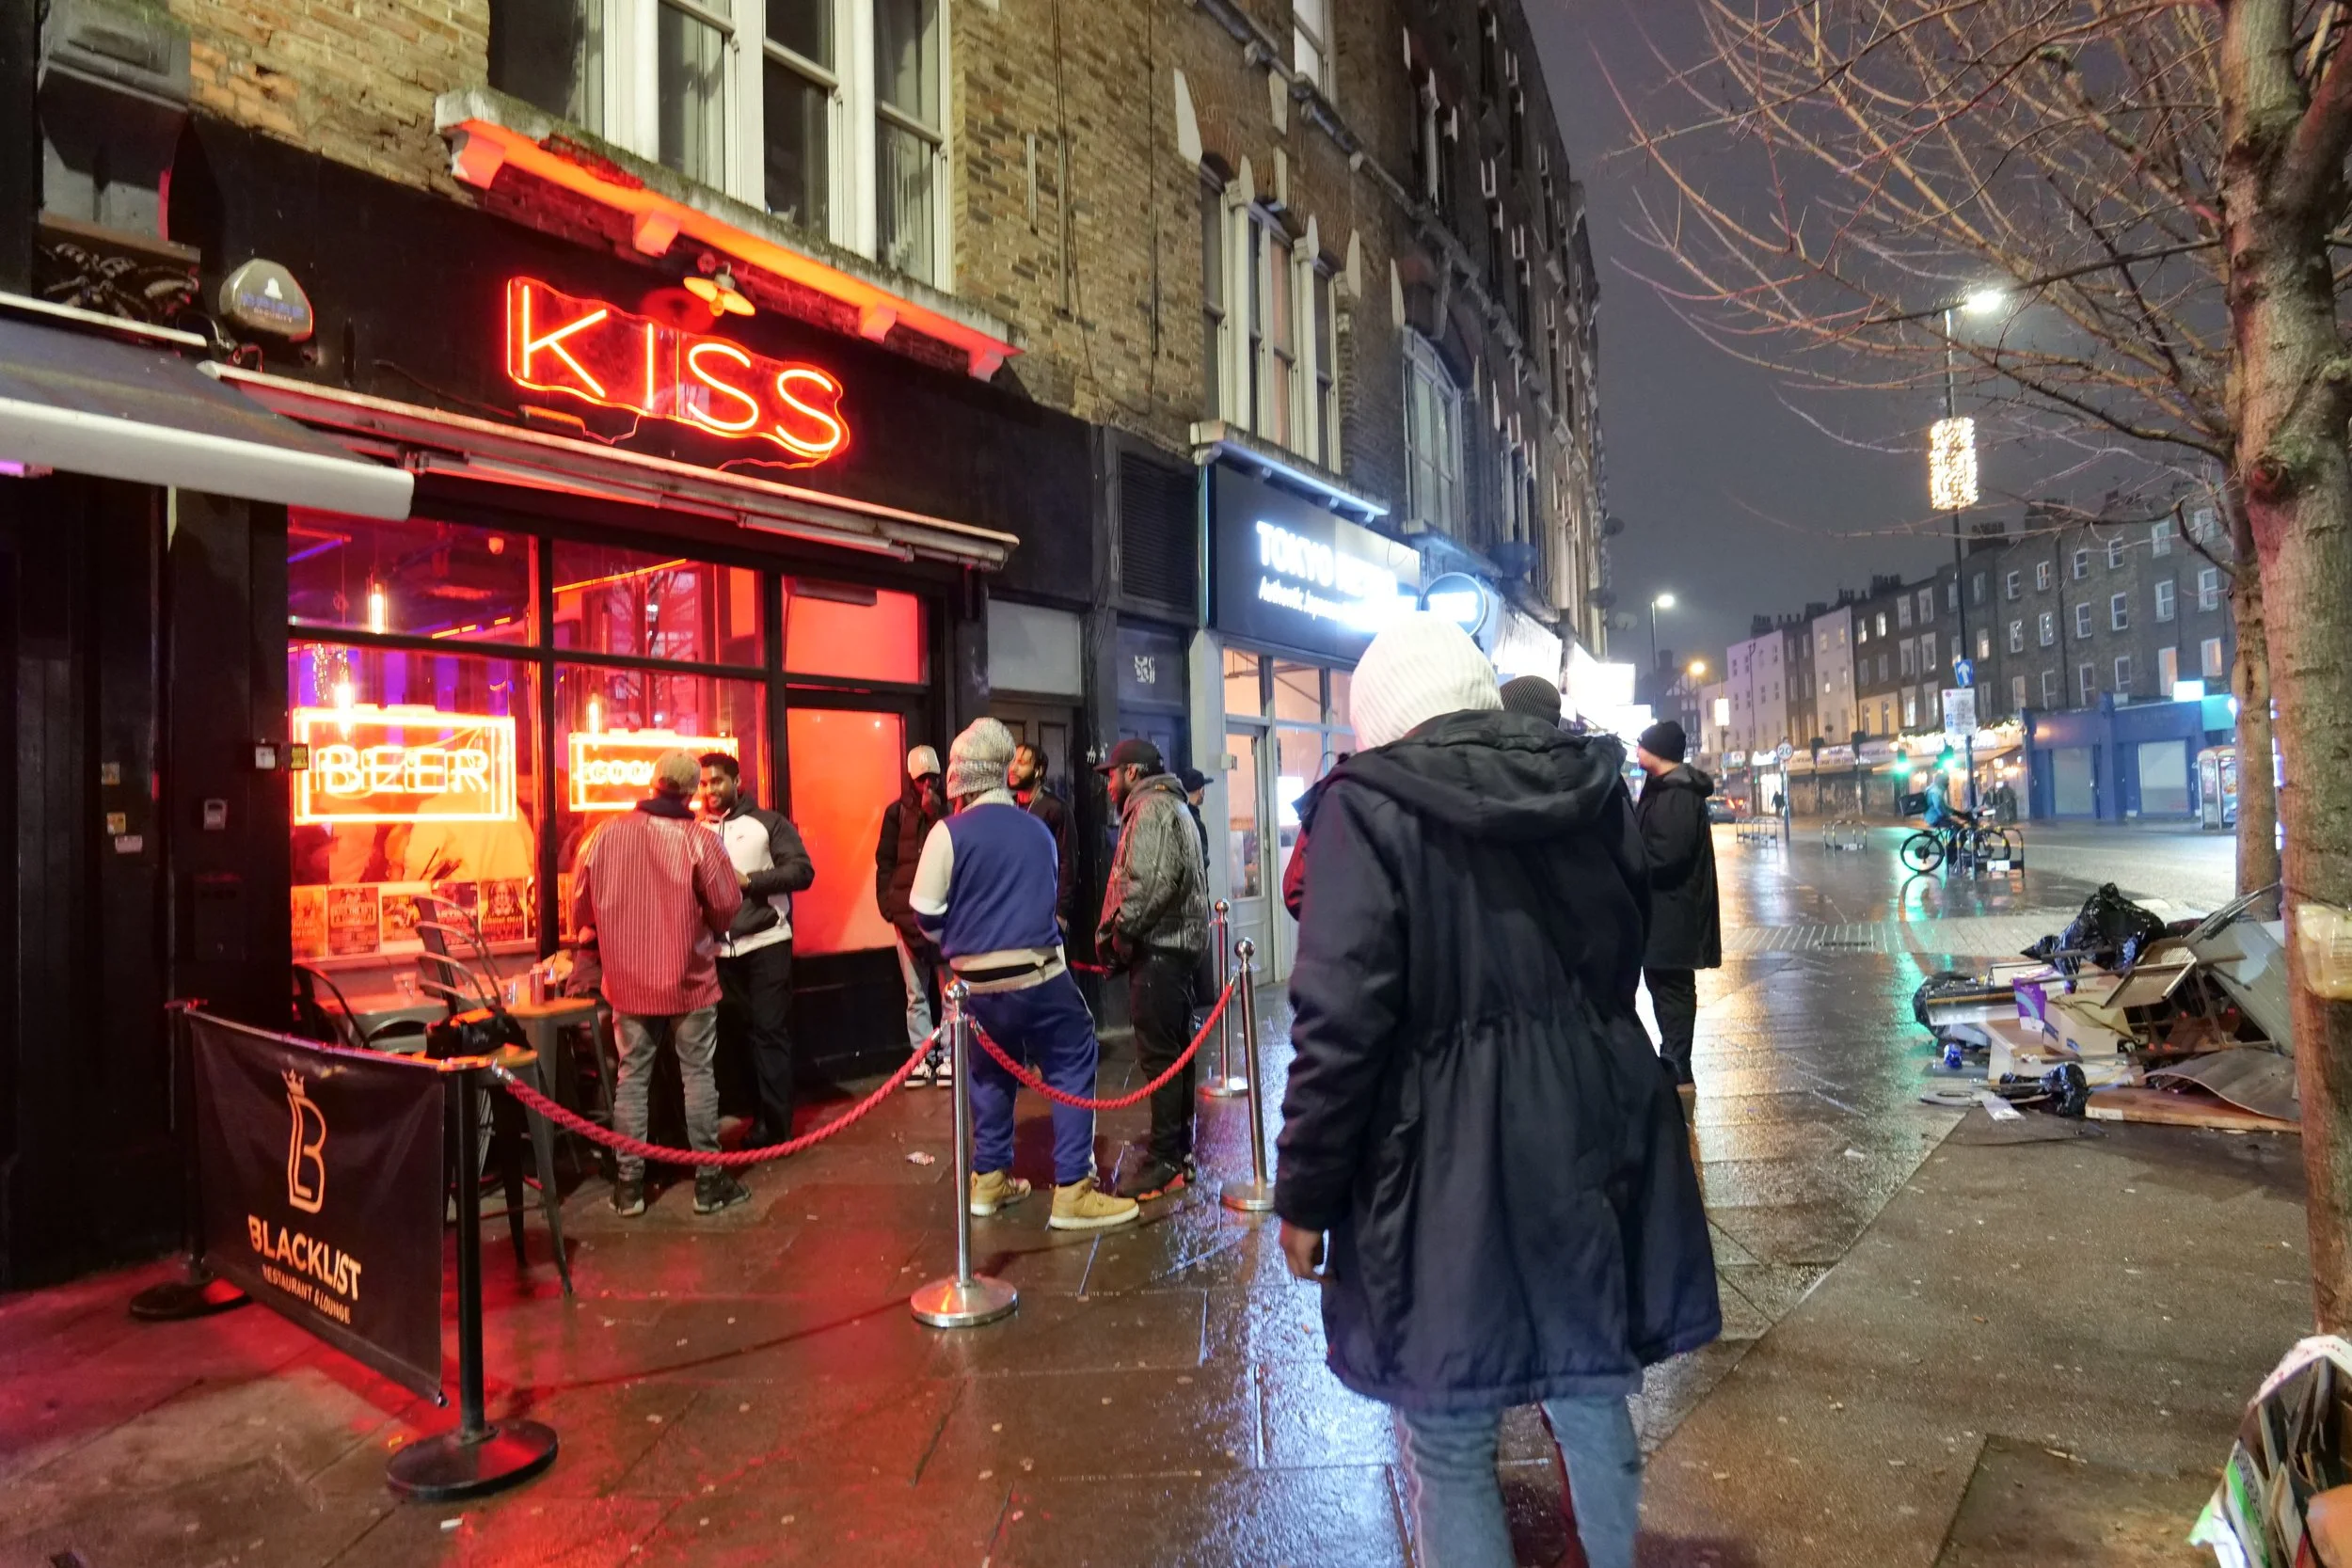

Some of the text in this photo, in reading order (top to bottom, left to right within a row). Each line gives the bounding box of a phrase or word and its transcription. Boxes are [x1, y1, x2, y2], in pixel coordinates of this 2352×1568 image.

[522, 283, 842, 452] KISS
[1255, 519, 1334, 588] TOKYO
[321, 744, 489, 794] BEER
[1779, 746, 1792, 756] 20
[247, 1213, 362, 1301] BLACKLIST
[262, 1263, 313, 1303] RESTAURANT
[319, 1291, 351, 1325] LOUNGE
